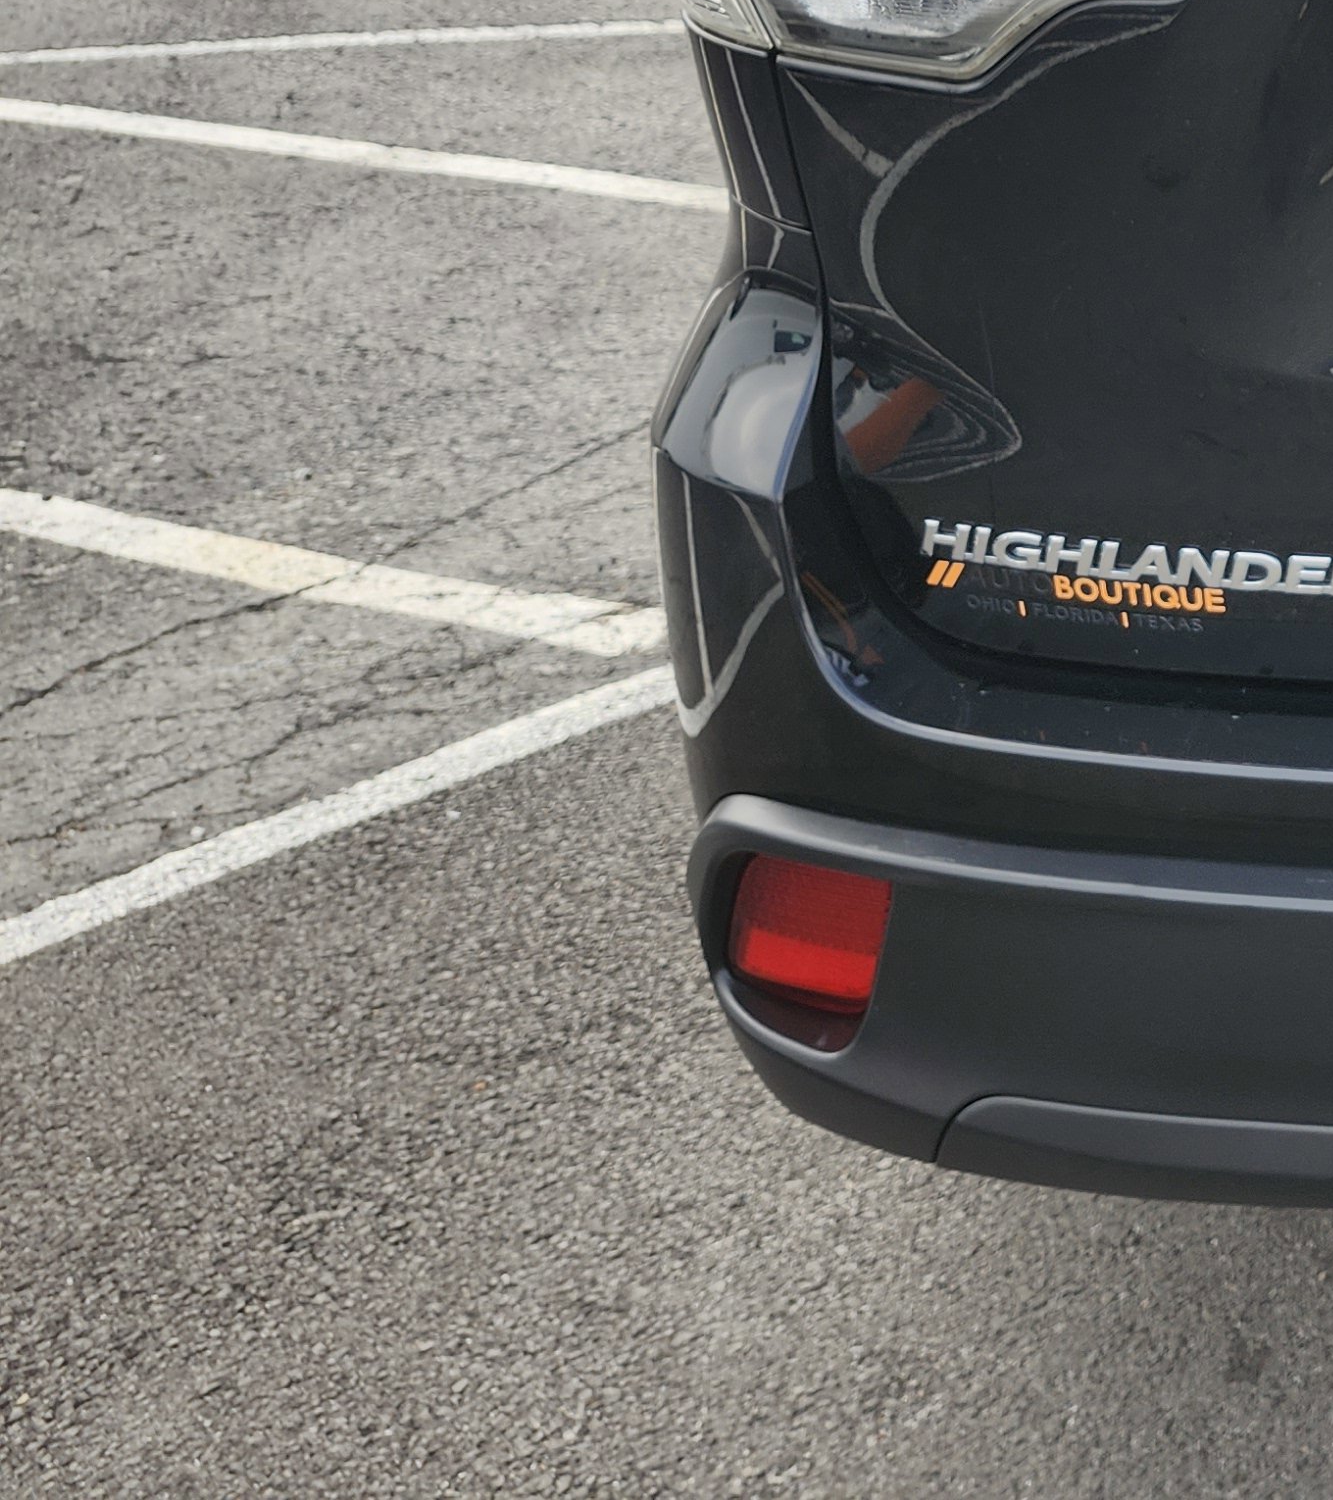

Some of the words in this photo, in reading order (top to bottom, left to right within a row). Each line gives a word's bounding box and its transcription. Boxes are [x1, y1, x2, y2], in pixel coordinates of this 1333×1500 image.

[966, 594, 1017, 615] OHIO
[1032, 603, 1116, 626] FLORIDA
[1134, 612, 1205, 633] TEXAS
